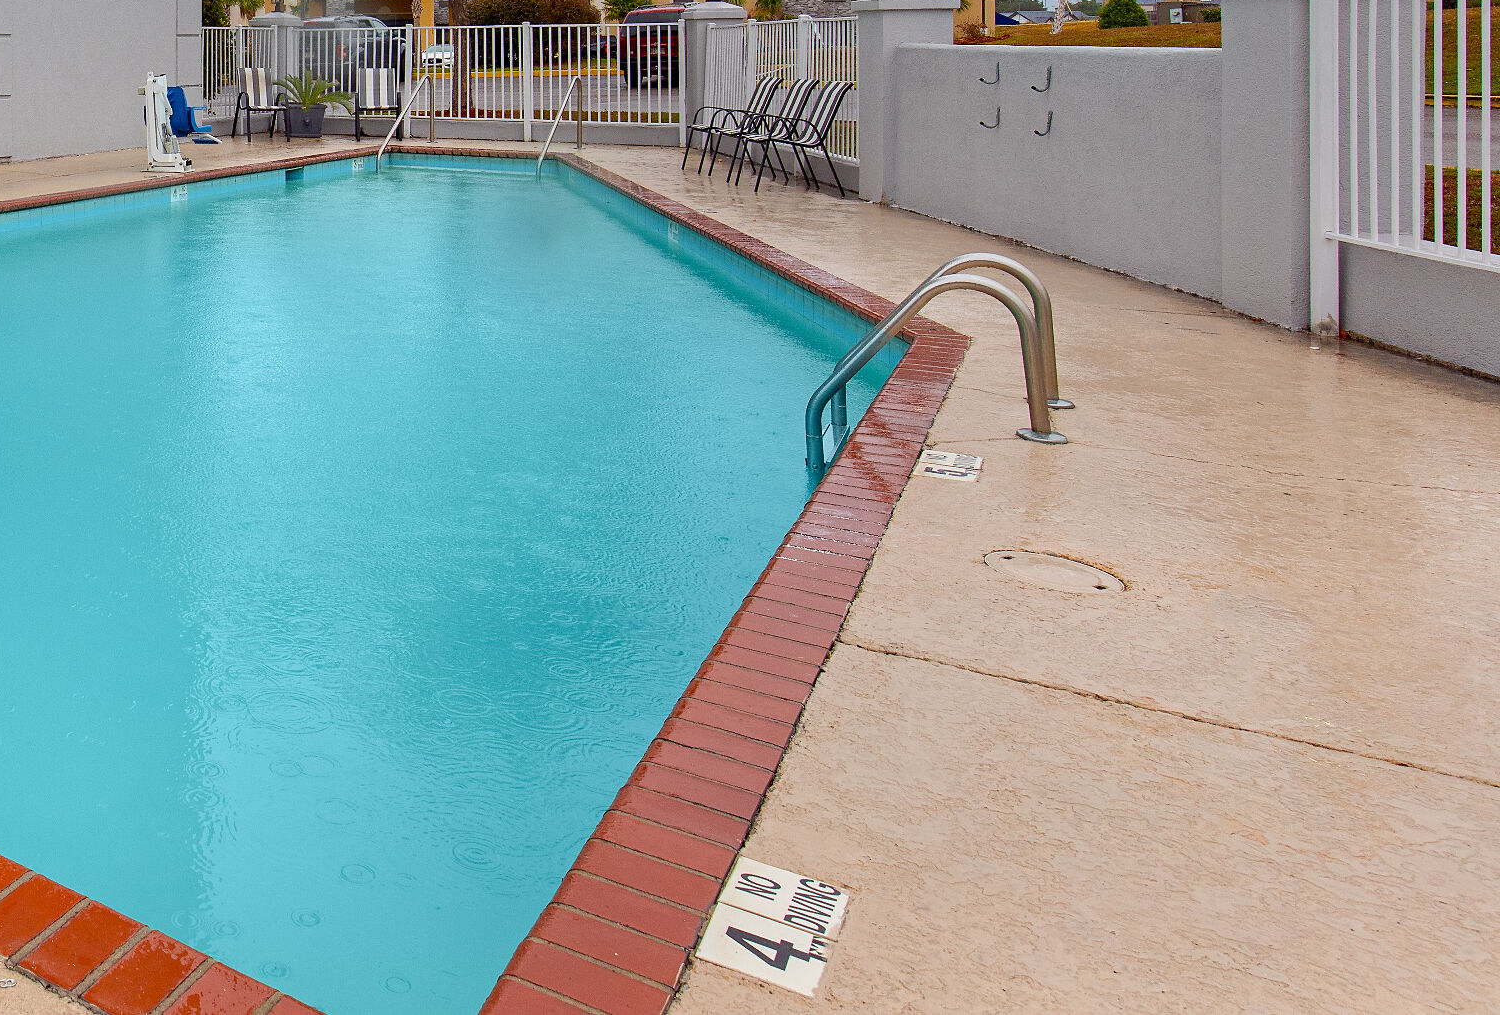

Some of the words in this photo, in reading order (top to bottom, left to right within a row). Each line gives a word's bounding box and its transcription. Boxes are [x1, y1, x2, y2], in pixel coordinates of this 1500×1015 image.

[735, 873, 781, 901] NO
[783, 878, 842, 934] DIVING
[725, 926, 811, 971] 4
